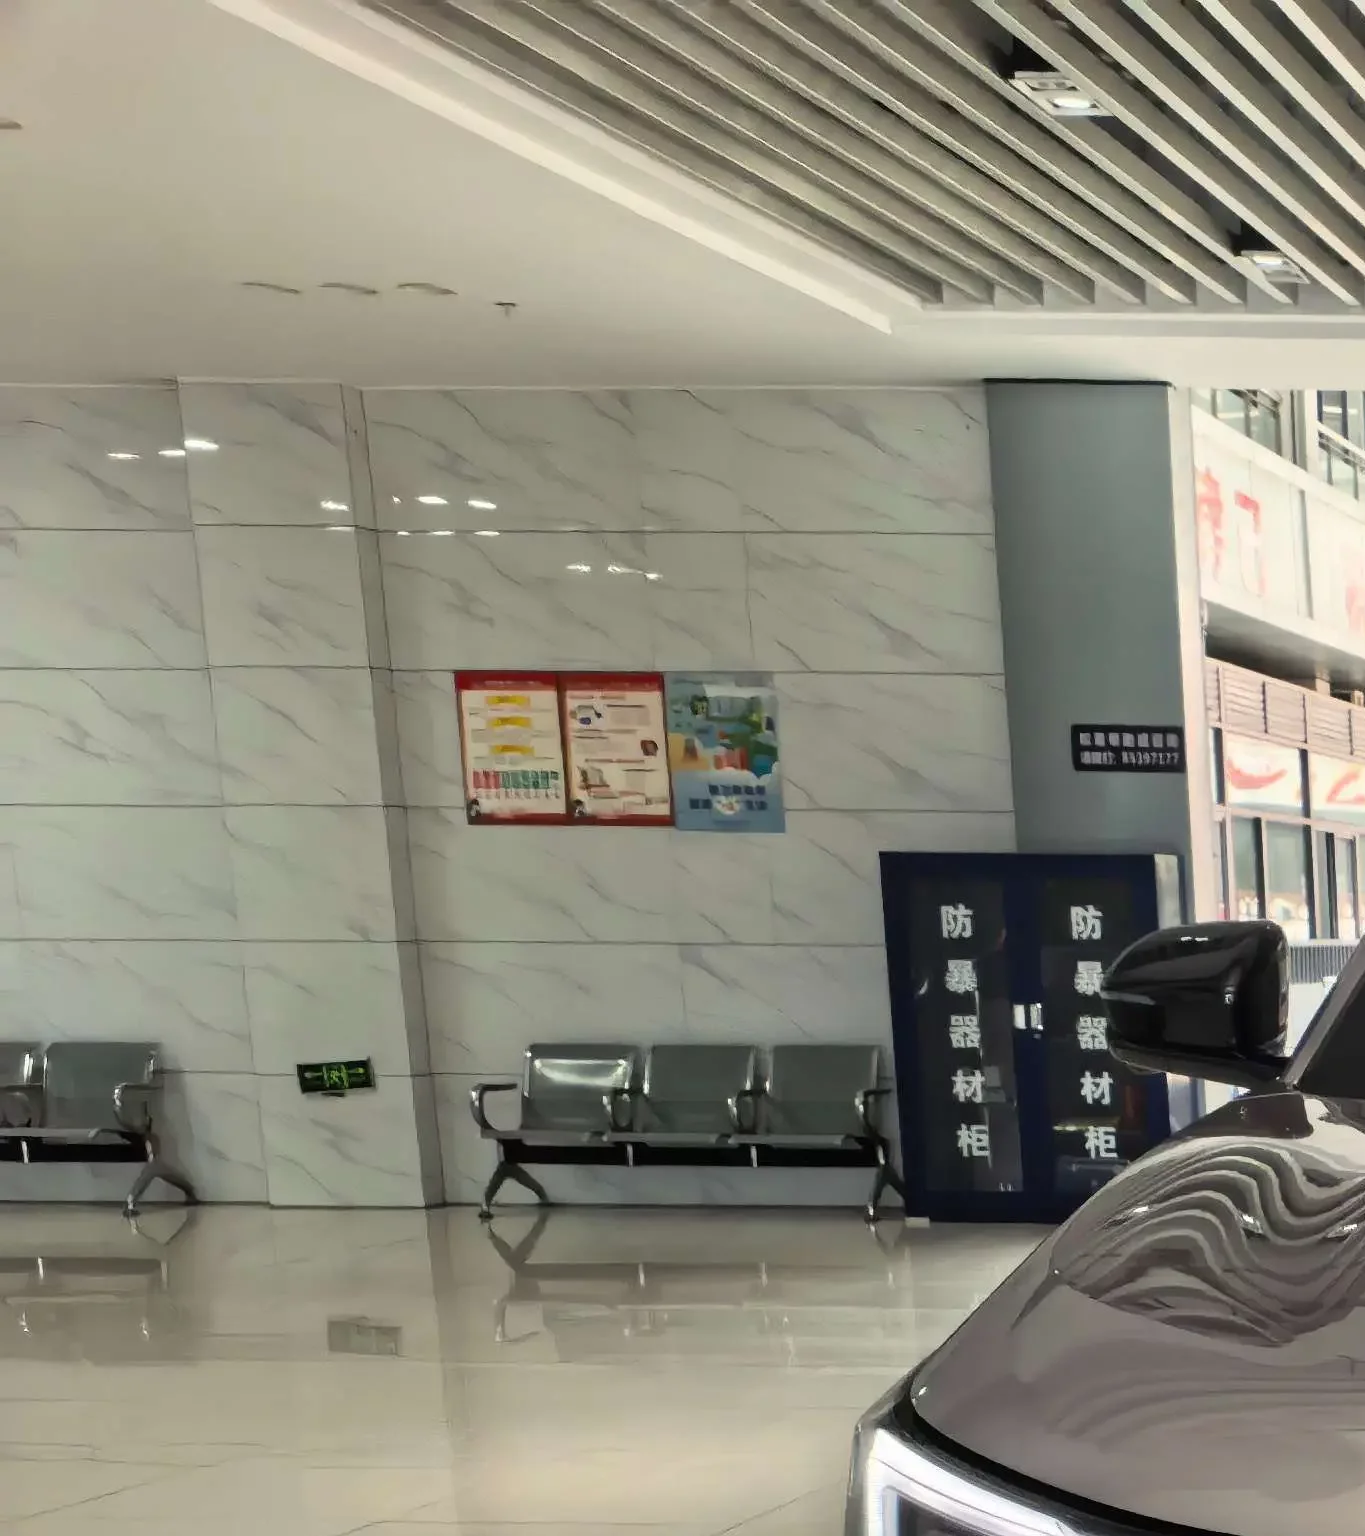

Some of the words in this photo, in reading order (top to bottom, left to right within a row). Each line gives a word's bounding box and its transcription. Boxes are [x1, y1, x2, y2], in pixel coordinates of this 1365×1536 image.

[940, 903, 991, 1158] 防暴器材柜
[1070, 904, 1118, 1160] 防暴器材柜
